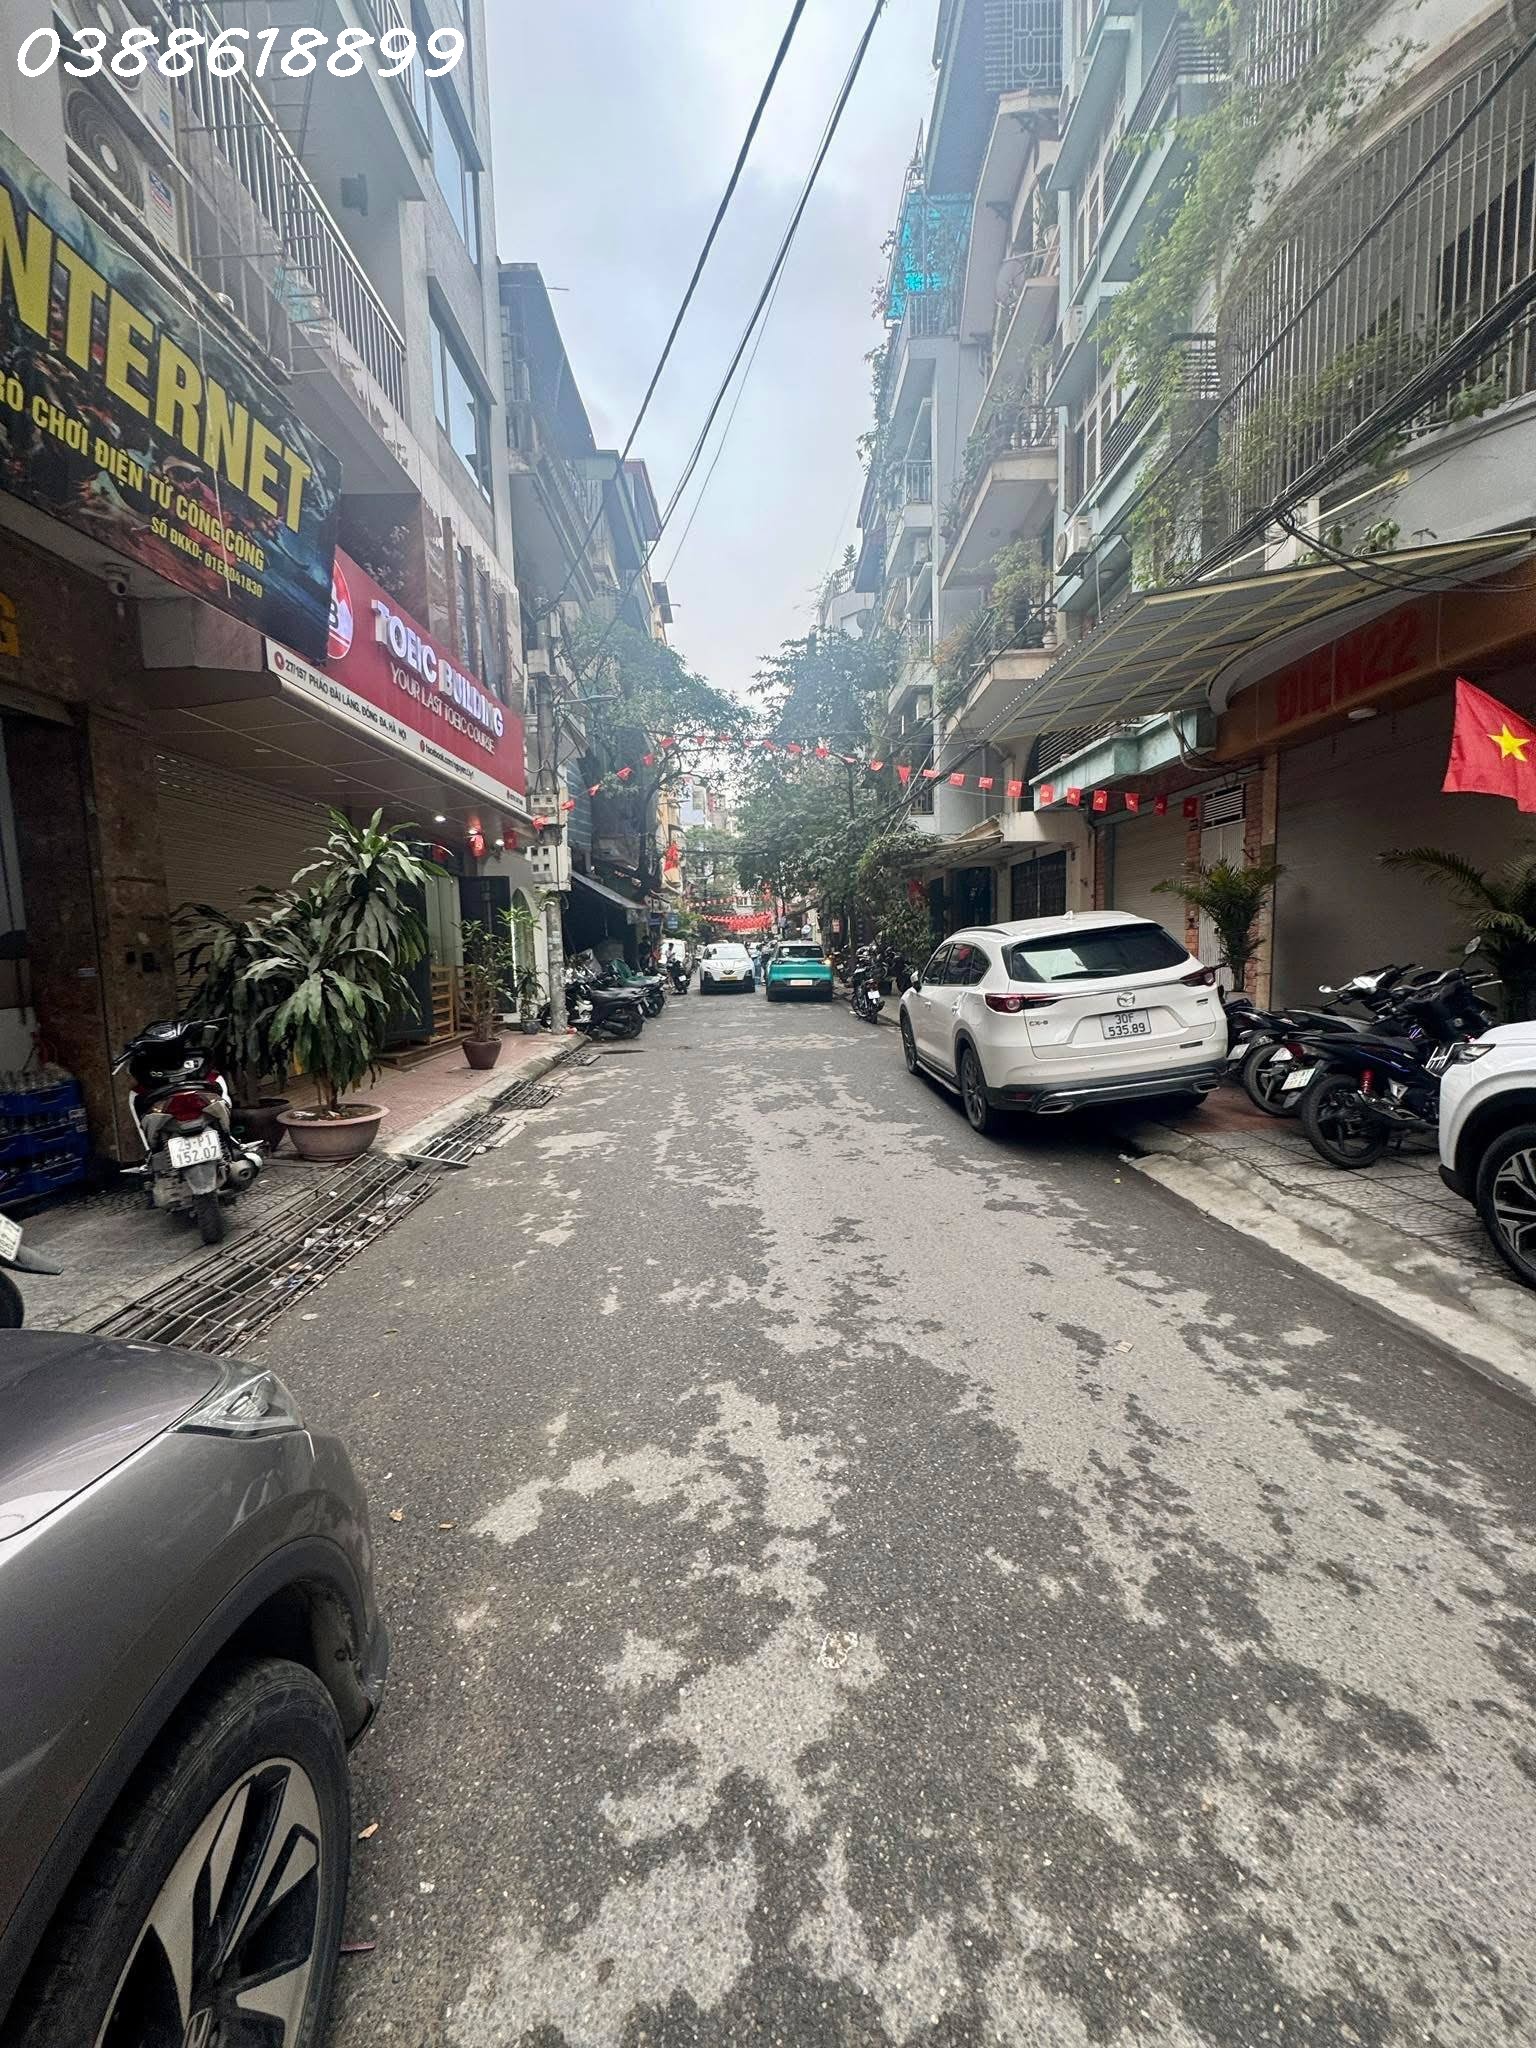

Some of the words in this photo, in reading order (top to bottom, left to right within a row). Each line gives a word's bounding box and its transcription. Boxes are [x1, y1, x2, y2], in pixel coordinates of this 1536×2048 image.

[31, 395, 88, 457] CHƠI
[94, 437, 144, 493] ĐIỆN
[149, 473, 174, 510] TỬ
[176, 494, 222, 545] CÔNG
[225, 528, 265, 573] CỘNG
[151, 516, 168, 539] SỐ
[372, 599, 437, 684] TOEIC
[439, 659, 504, 738] BUILDING
[390, 661, 420, 702] YOUR
[421, 687, 442, 717] LAST
[444, 703, 467, 734] TOEIC
[1108, 1022, 1146, 1037] 535.89
[1115, 1012, 1134, 1026] 30F
[176, 1146, 217, 1165] 152.07
